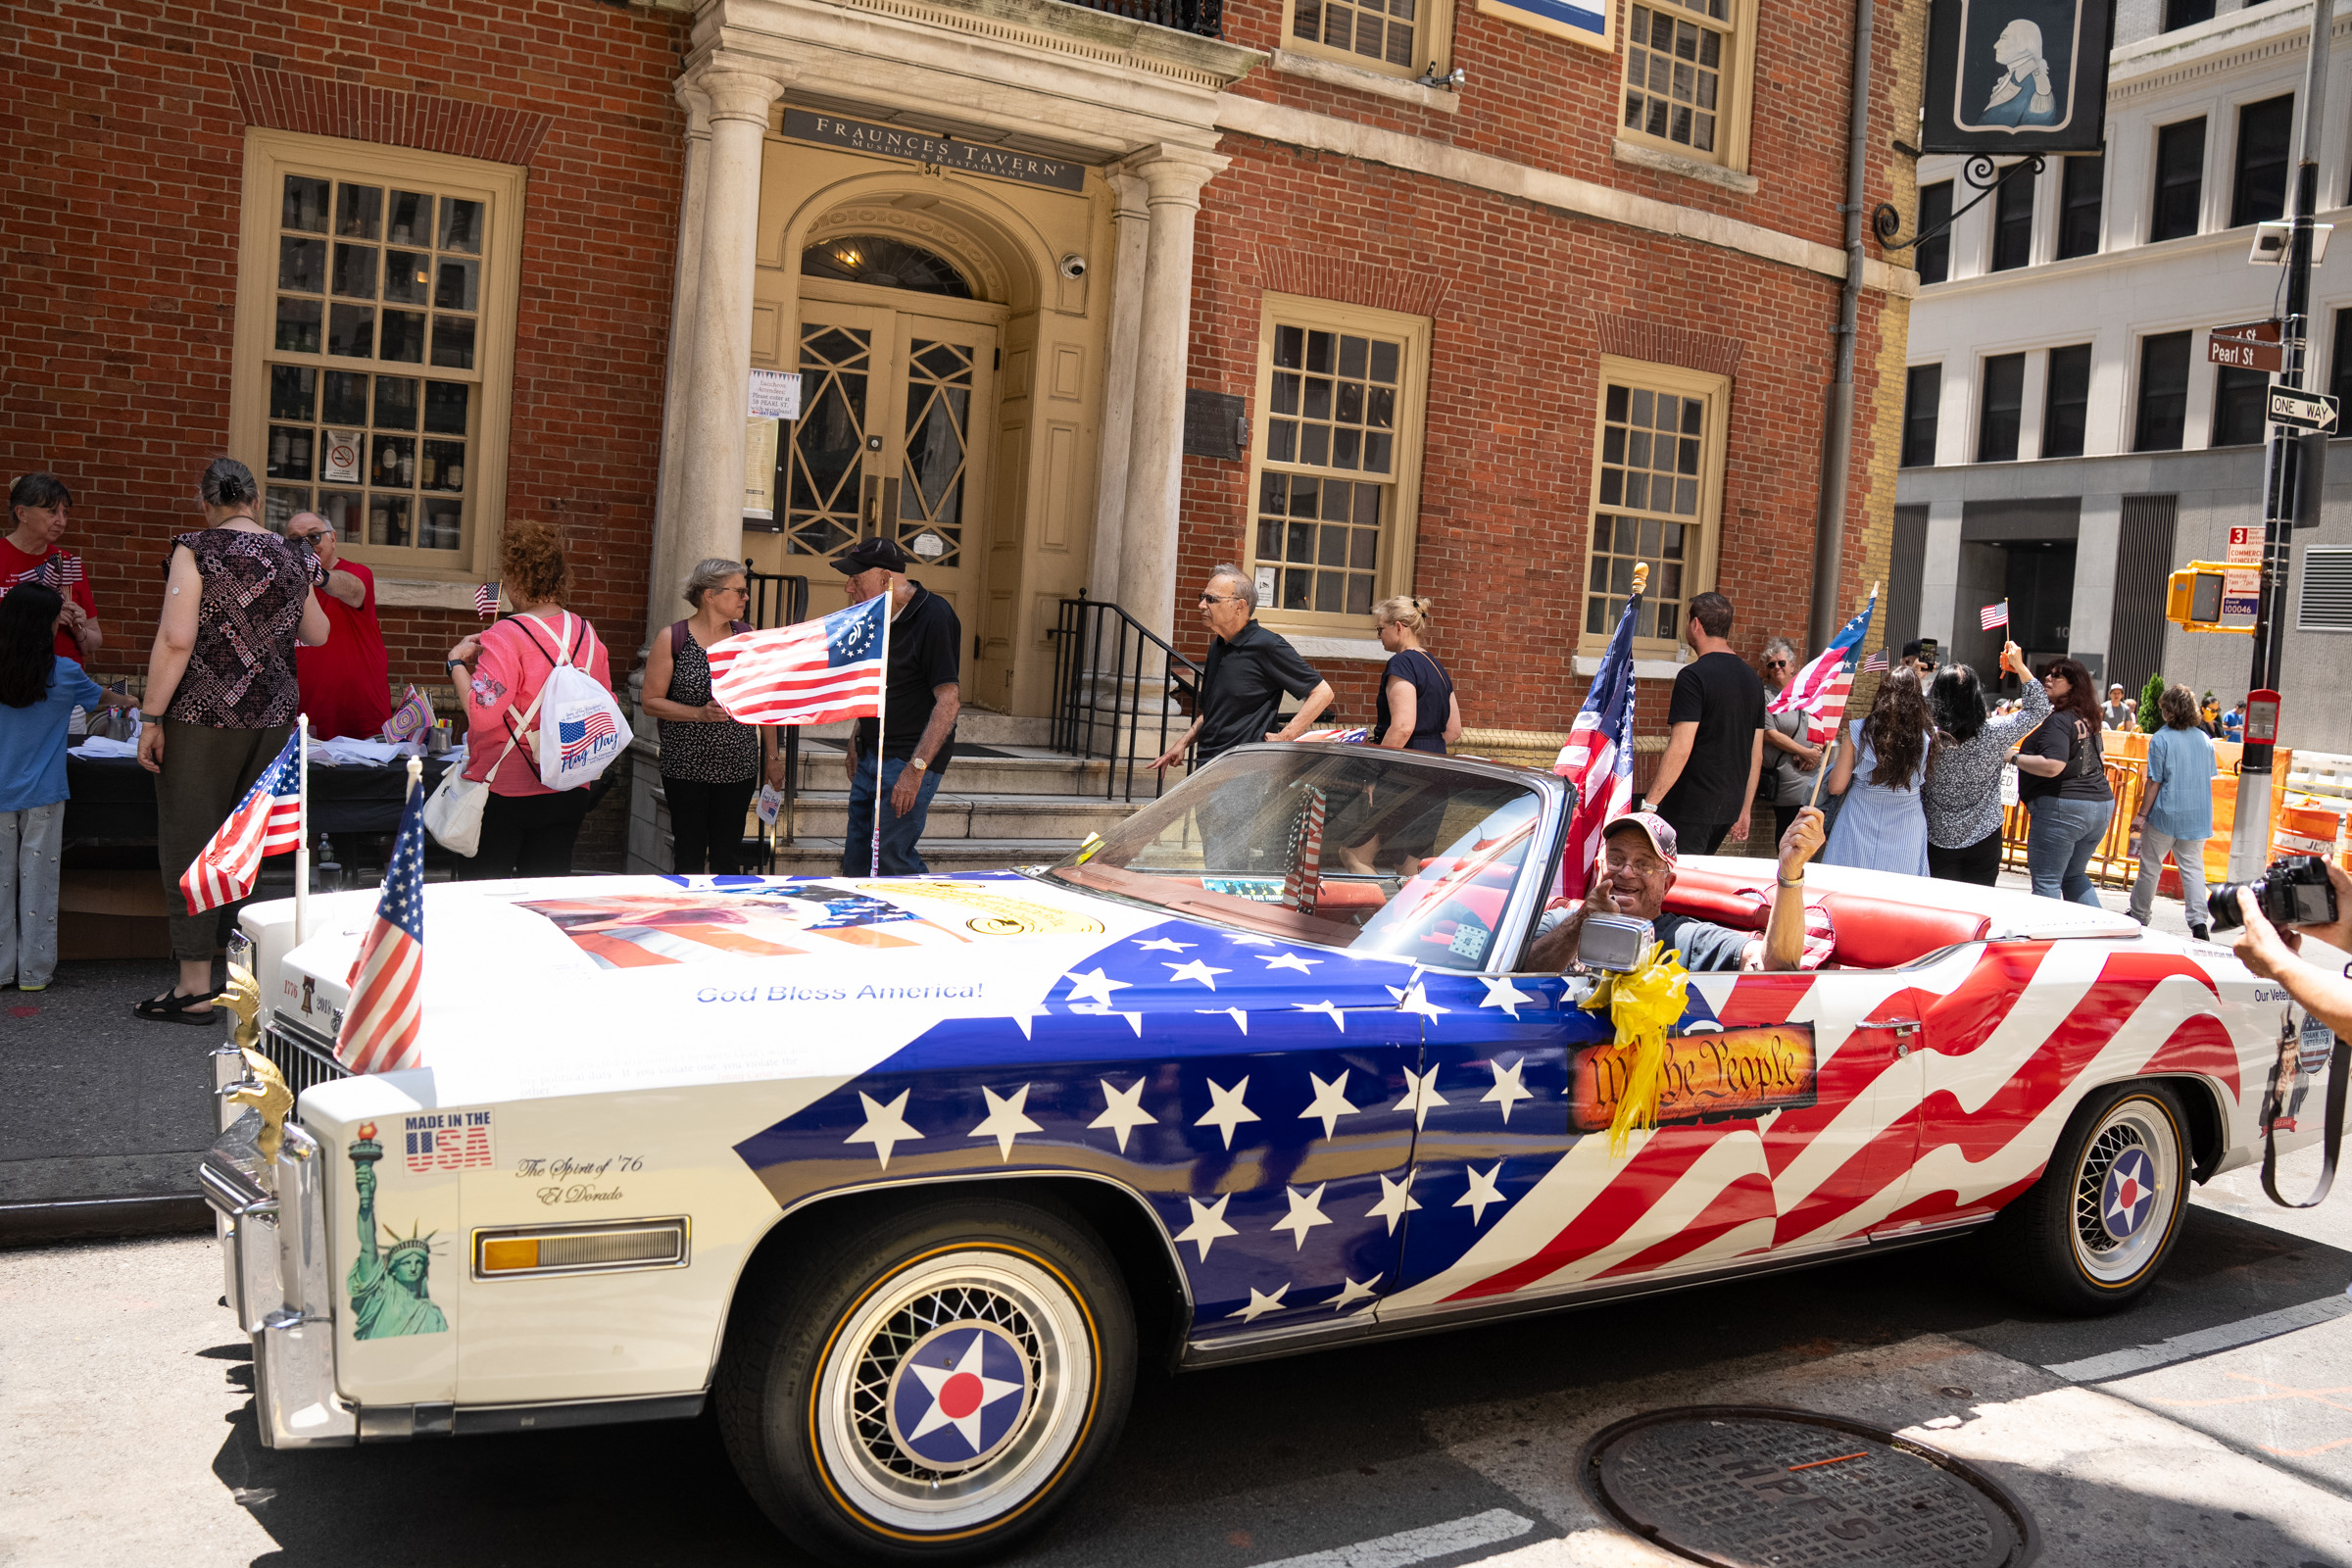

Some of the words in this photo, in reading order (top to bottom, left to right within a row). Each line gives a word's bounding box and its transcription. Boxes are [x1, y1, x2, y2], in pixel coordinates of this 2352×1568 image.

[815, 118, 950, 155] FRAUNCES
[851, 138, 912, 157] MUSEUM
[936, 154, 1025, 178] RESTAURANT
[924, 162, 941, 177] 54
[2212, 342, 2239, 364] Pearl
[2242, 347, 2254, 366] St
[2275, 397, 2295, 414] ONE
[2306, 403, 2328, 420] WAY
[2234, 529, 2243, 544] 3
[2225, 605, 2251, 613] 100046
[562, 749, 591, 772] Flag
[594, 732, 619, 755] Day
[284, 980, 298, 999] 1776
[697, 985, 757, 1004] God
[767, 984, 847, 1002] Bless
[858, 983, 984, 1001] America!
[2254, 990, 2269, 1003] Our
[2270, 989, 2293, 1002] Veter
[745, 1057, 780, 1069] violate
[782, 1055, 800, 1066] the
[1698, 1035, 1801, 1100] People
[405, 1114, 444, 1131] MADE
[448, 1113, 463, 1128] IN
[466, 1111, 491, 1127] THE
[406, 1127, 493, 1172] USA
[515, 1157, 546, 1178] The
[549, 1156, 593, 1182] Spirit
[592, 1158, 612, 1181] of
[617, 1154, 646, 1173] '76
[536, 1186, 563, 1205] El
[564, 1184, 624, 1204] Dorado
